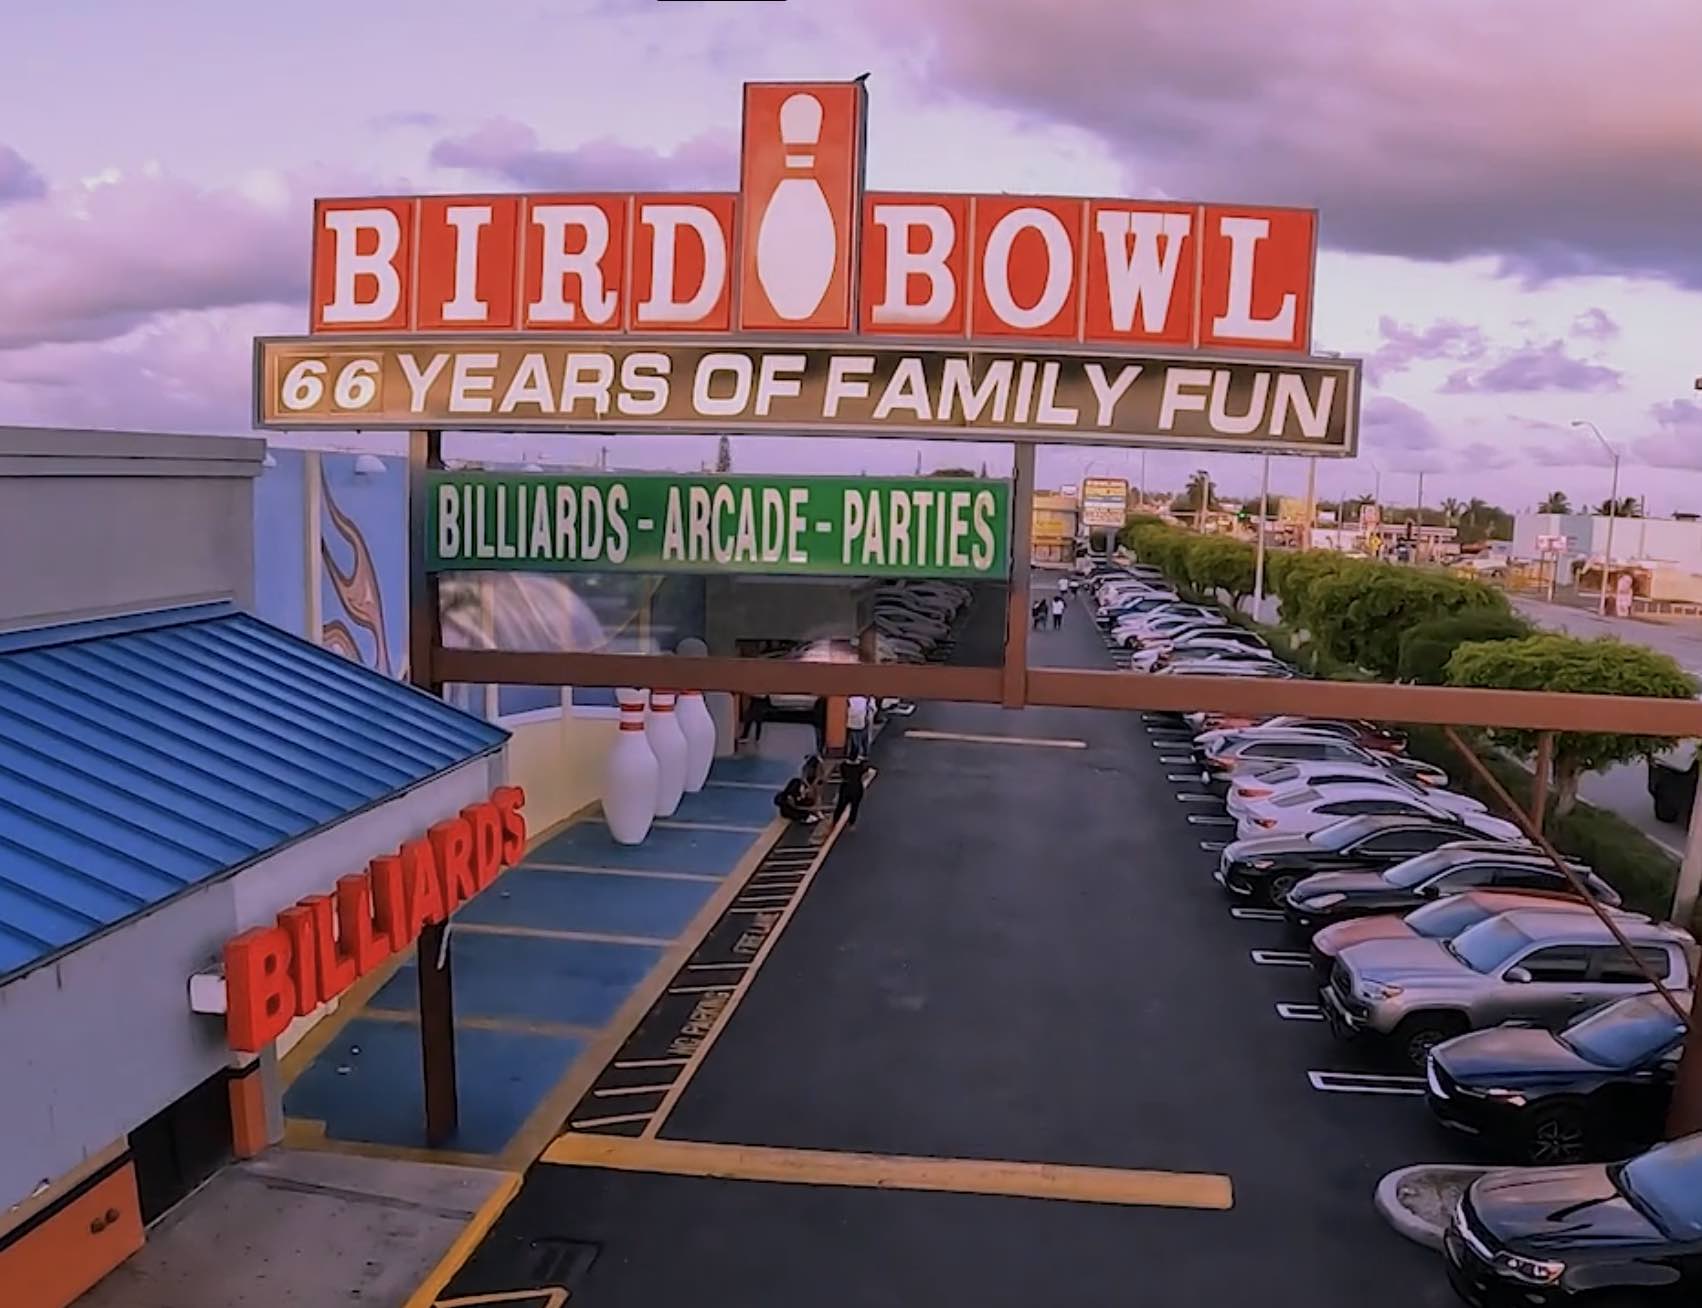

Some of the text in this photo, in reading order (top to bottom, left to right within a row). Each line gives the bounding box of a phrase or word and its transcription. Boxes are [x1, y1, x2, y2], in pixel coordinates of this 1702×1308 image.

[322, 203, 1297, 342] BIRD BOWL
[281, 353, 1337, 438] 66 YEARS OF FAMILY FUN
[438, 484, 629, 564] BILLIARDS
[662, 485, 809, 565] ARCADE
[843, 489, 996, 571] PARTIES
[224, 786, 527, 1053] BILLIARDS
